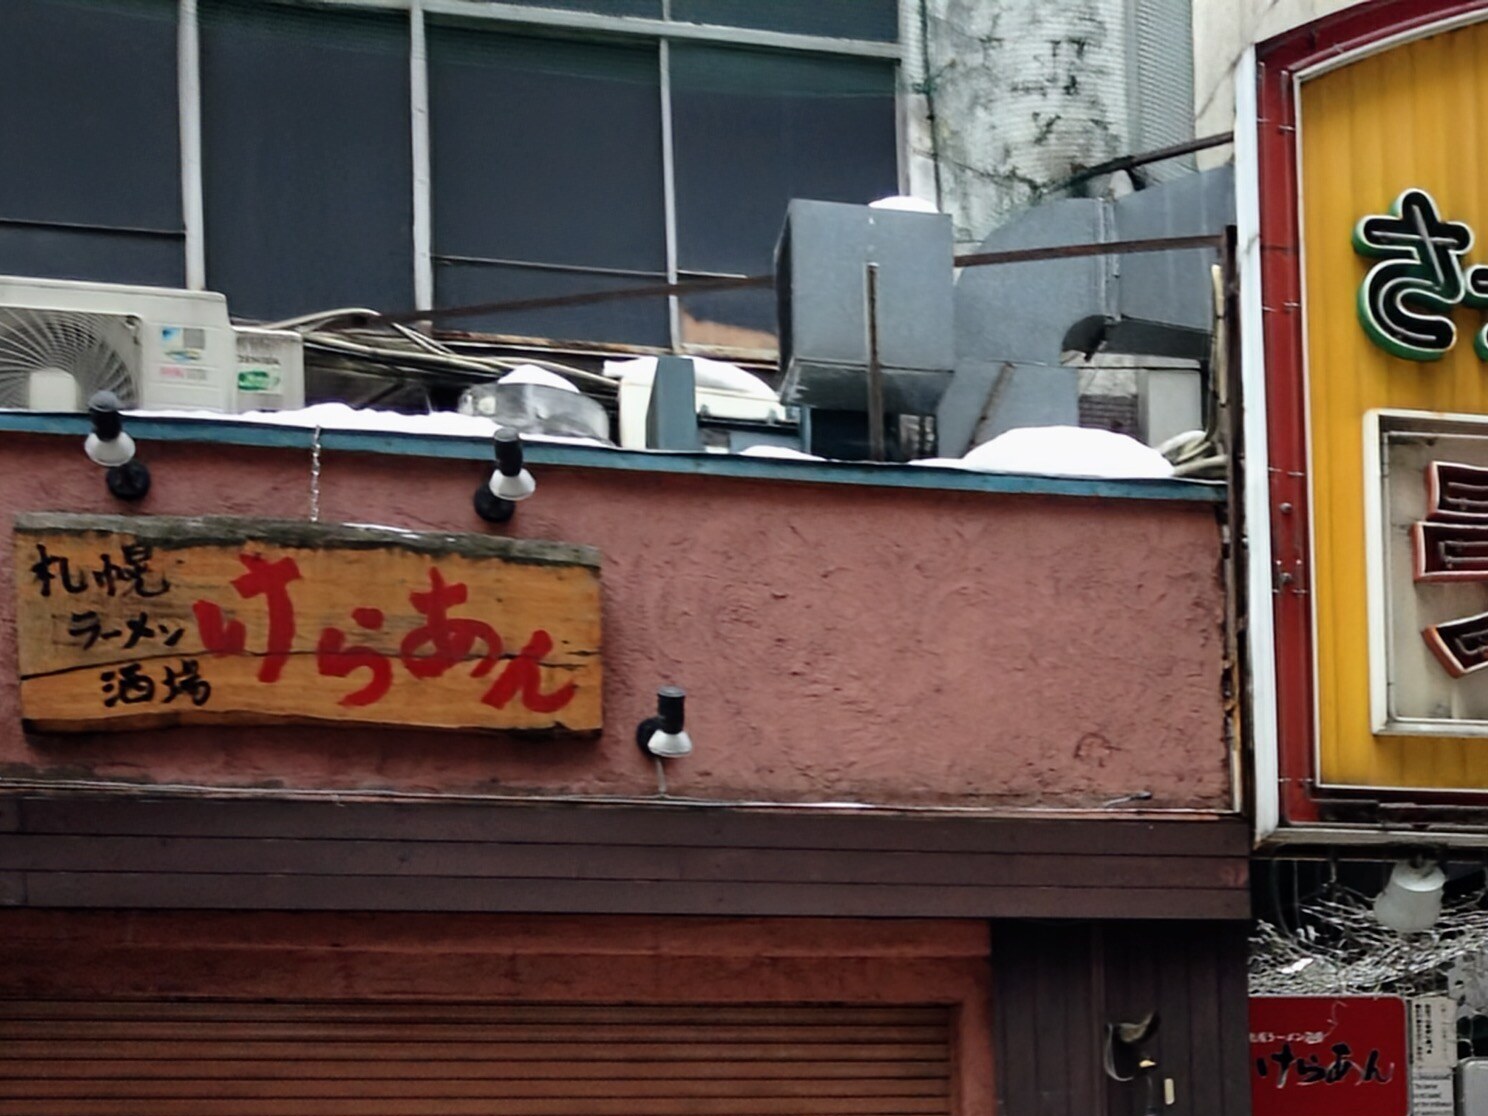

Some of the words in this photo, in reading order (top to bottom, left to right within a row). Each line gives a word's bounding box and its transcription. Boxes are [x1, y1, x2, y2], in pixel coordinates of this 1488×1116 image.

[31, 543, 171, 598] 札幌
[69, 611, 185, 649] ラーメン
[193, 553, 577, 713] けらあん
[100, 659, 212, 708] 酒場
